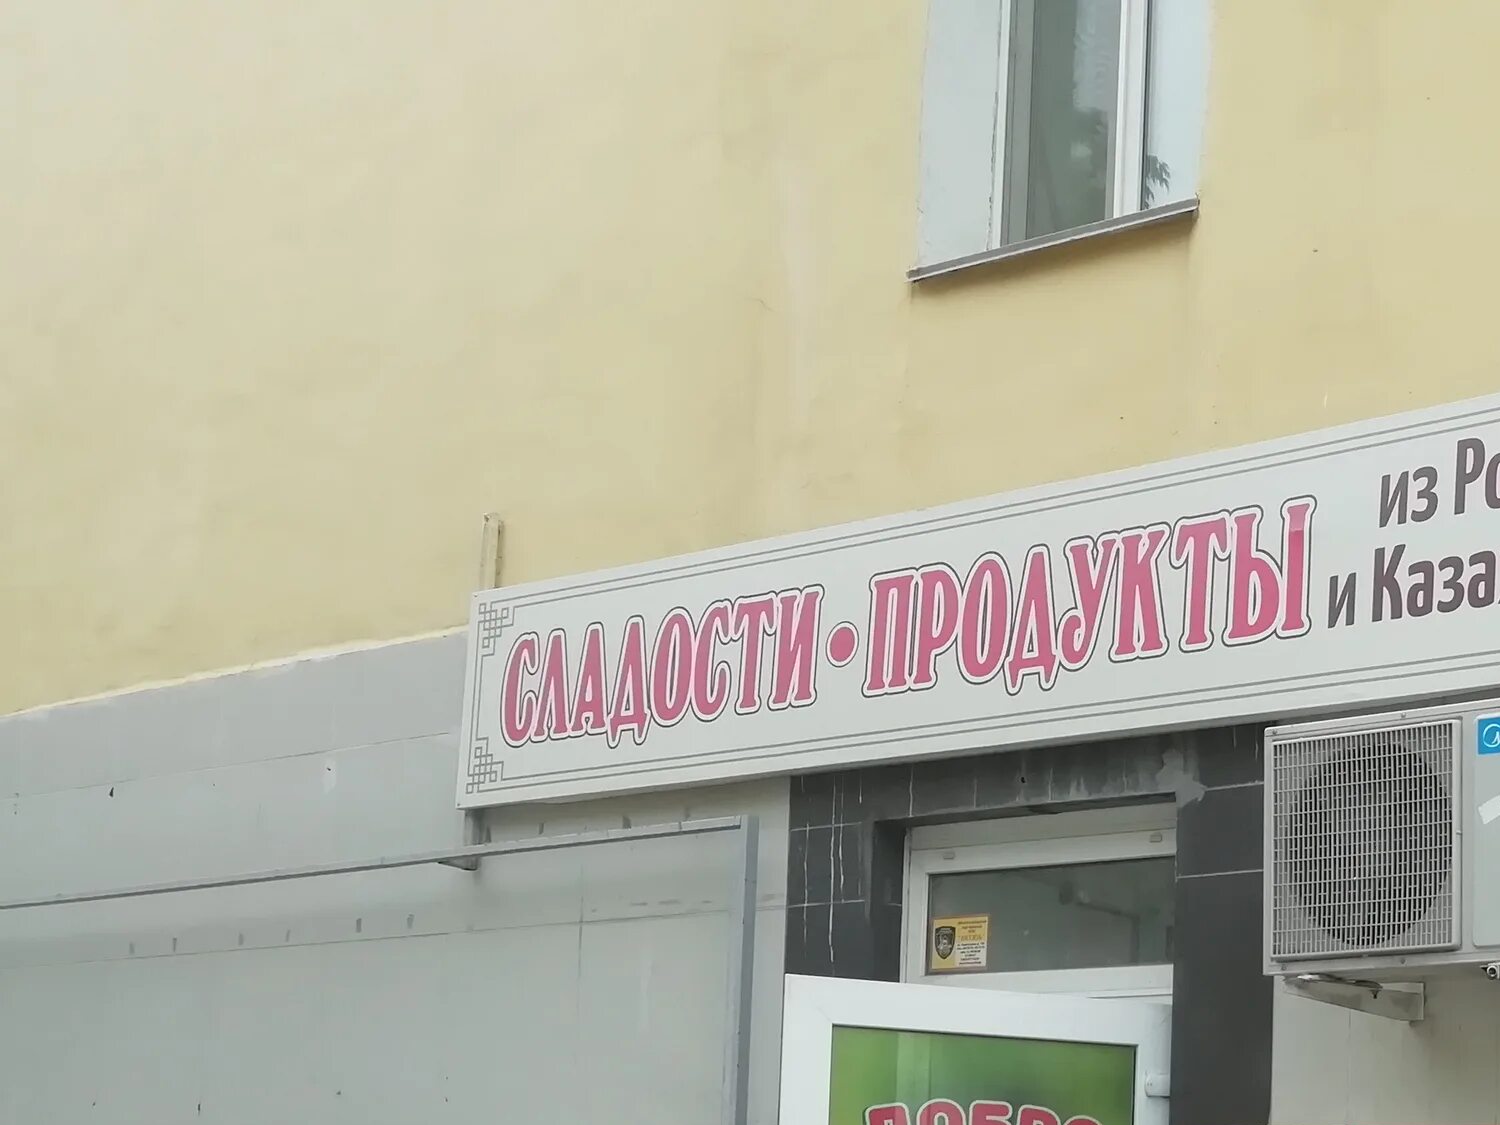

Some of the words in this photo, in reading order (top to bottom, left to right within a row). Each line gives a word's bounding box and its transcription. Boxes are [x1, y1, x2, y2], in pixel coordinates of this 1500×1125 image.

[1378, 466, 1438, 528] из
[501, 583, 824, 747] СЛАДОСТИ
[861, 495, 1318, 695] ПРОДУКТЫ
[1327, 572, 1357, 629] и
